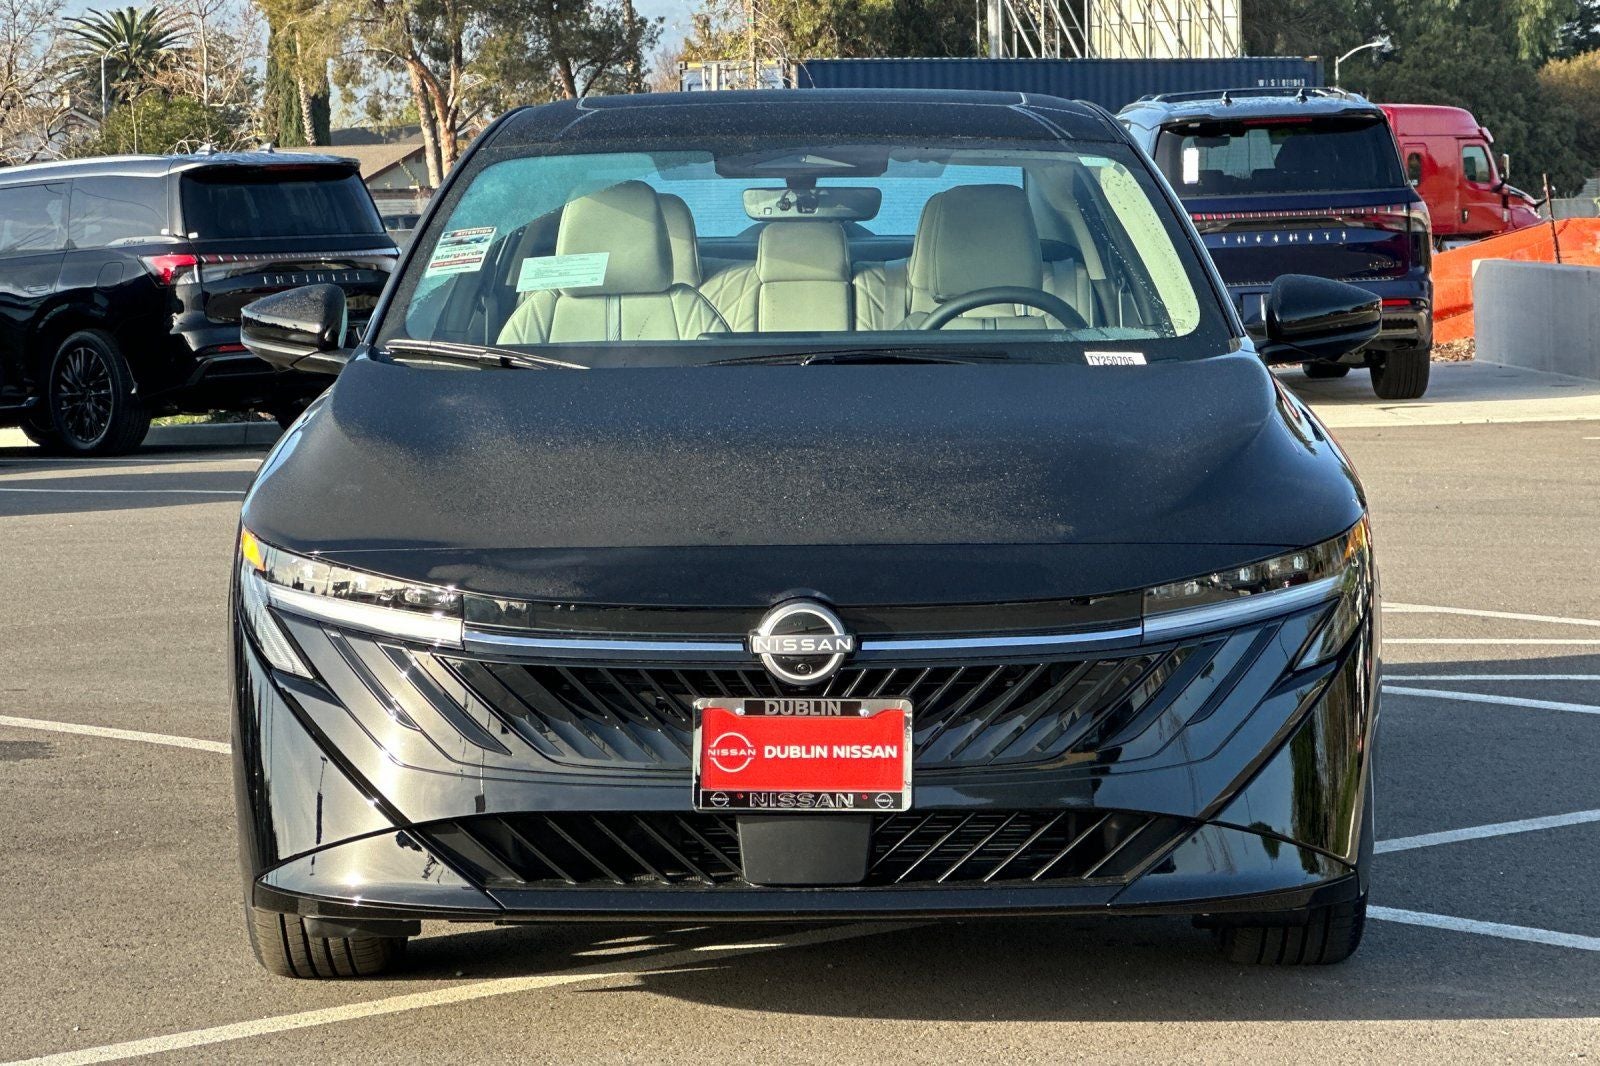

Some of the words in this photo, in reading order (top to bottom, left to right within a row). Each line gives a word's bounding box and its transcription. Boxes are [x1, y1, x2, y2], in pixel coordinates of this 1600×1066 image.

[757, 638, 851, 651] NISSAN
[764, 700, 841, 716] DUBLIN
[708, 748, 757, 756] NISSAN
[764, 745, 828, 759] DUBLIN
[832, 745, 898, 759] NISSAN
[750, 792, 854, 808] NISSAN
